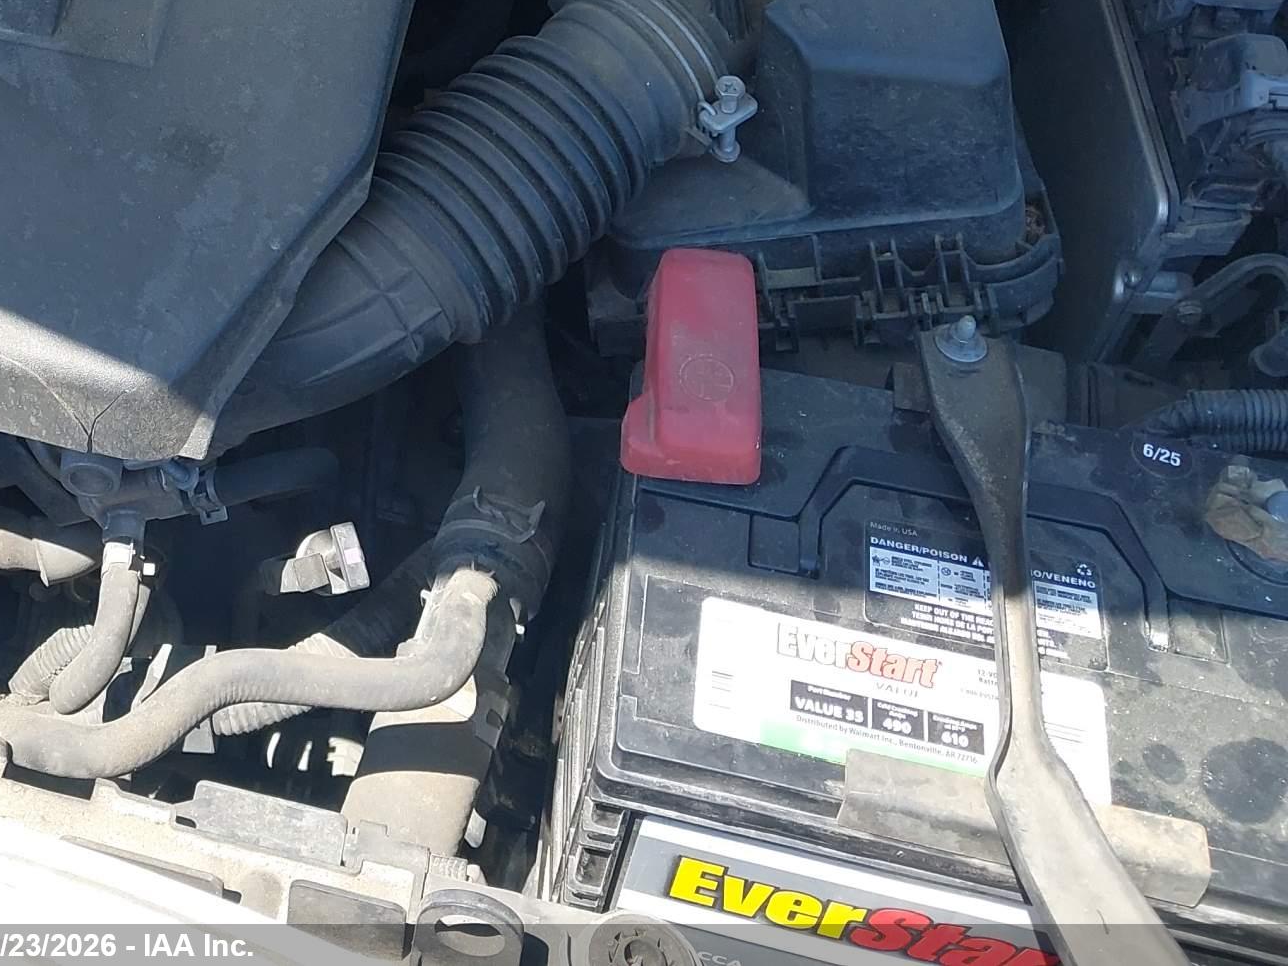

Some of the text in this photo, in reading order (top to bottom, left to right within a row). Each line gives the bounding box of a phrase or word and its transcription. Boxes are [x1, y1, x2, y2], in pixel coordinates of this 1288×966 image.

[1143, 443, 1181, 467] 6/25
[870, 521, 892, 532] Made
[902, 526, 918, 536] USA
[870, 536, 968, 563] DANGER/POISON
[777, 623, 938, 689] EverStart
[794, 696, 843, 719] VALUE
[882, 717, 912, 735] 490
[796, 715, 838, 731] Distributed
[839, 724, 848, 735] by
[848, 727, 880, 741] Walmart
[956, 751, 978, 764] 72716
[940, 731, 969, 748] 610
[667, 855, 1058, 966] EverStar
